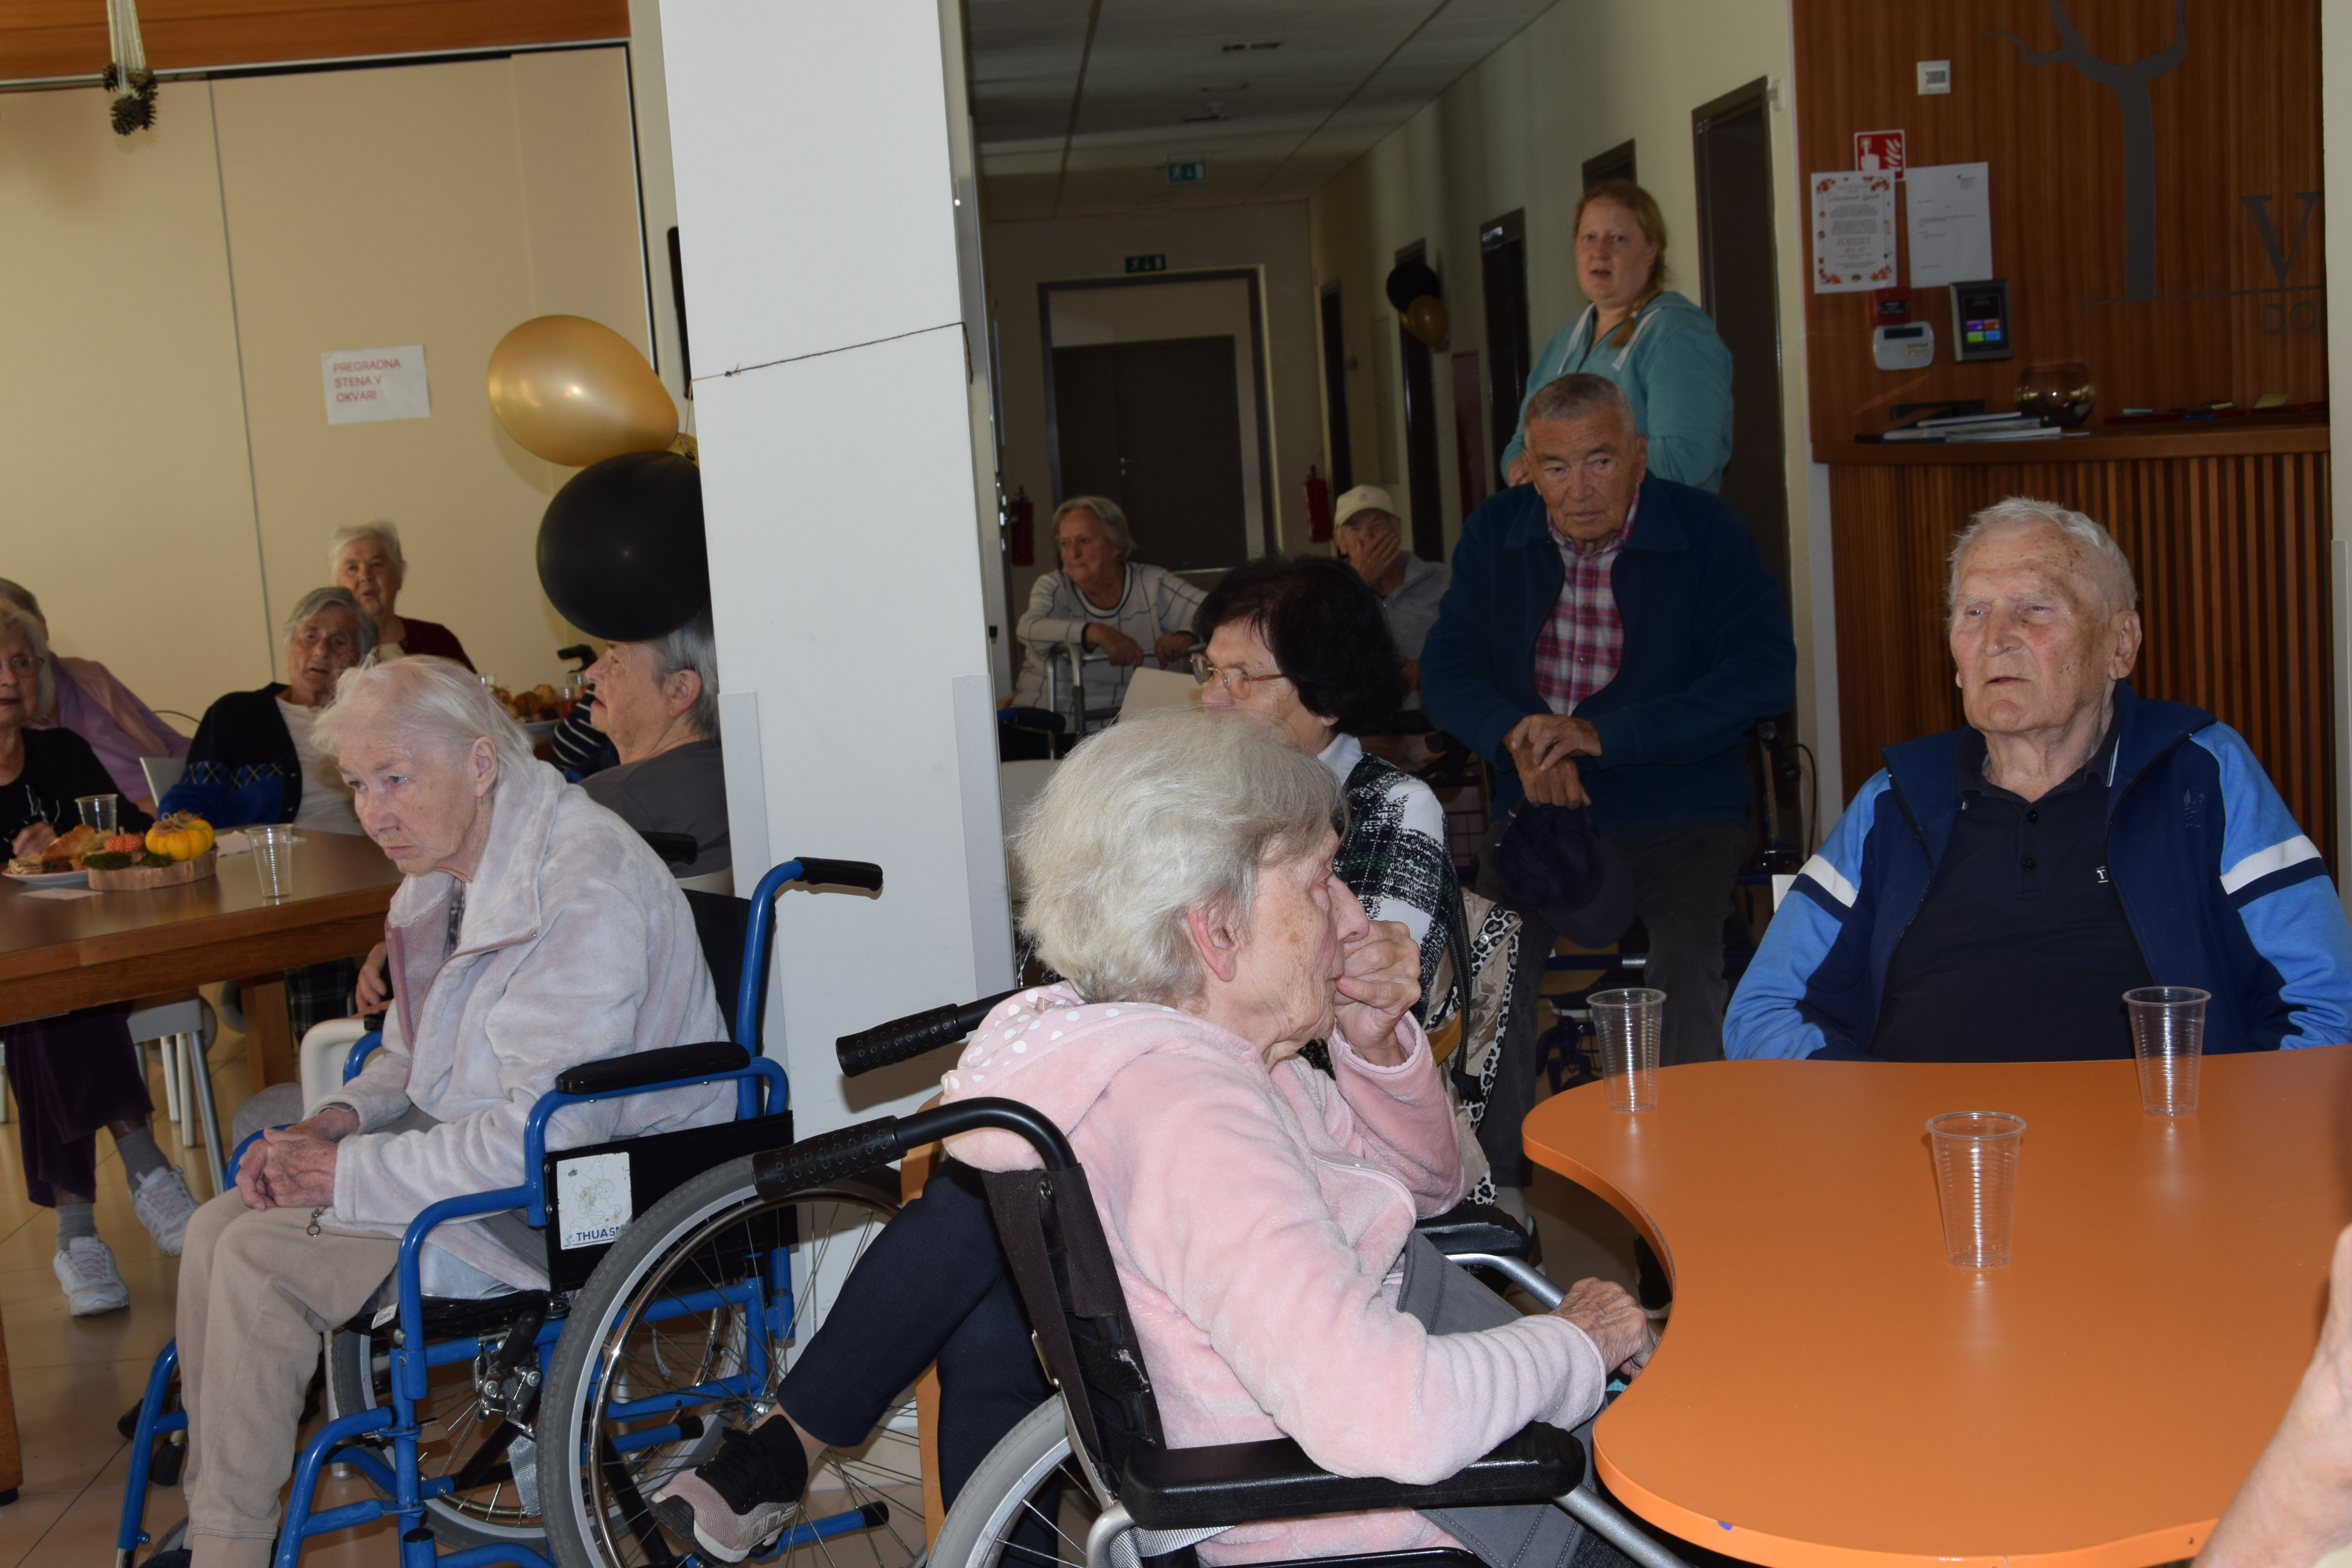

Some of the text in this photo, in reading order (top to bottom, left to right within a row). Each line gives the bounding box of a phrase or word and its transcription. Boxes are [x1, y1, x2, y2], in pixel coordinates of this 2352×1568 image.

[2264, 301, 2327, 336] DO
[333, 359, 401, 372] PREGRADNA
[335, 374, 382, 388] STENA V
[336, 390, 377, 403] OKVARI
